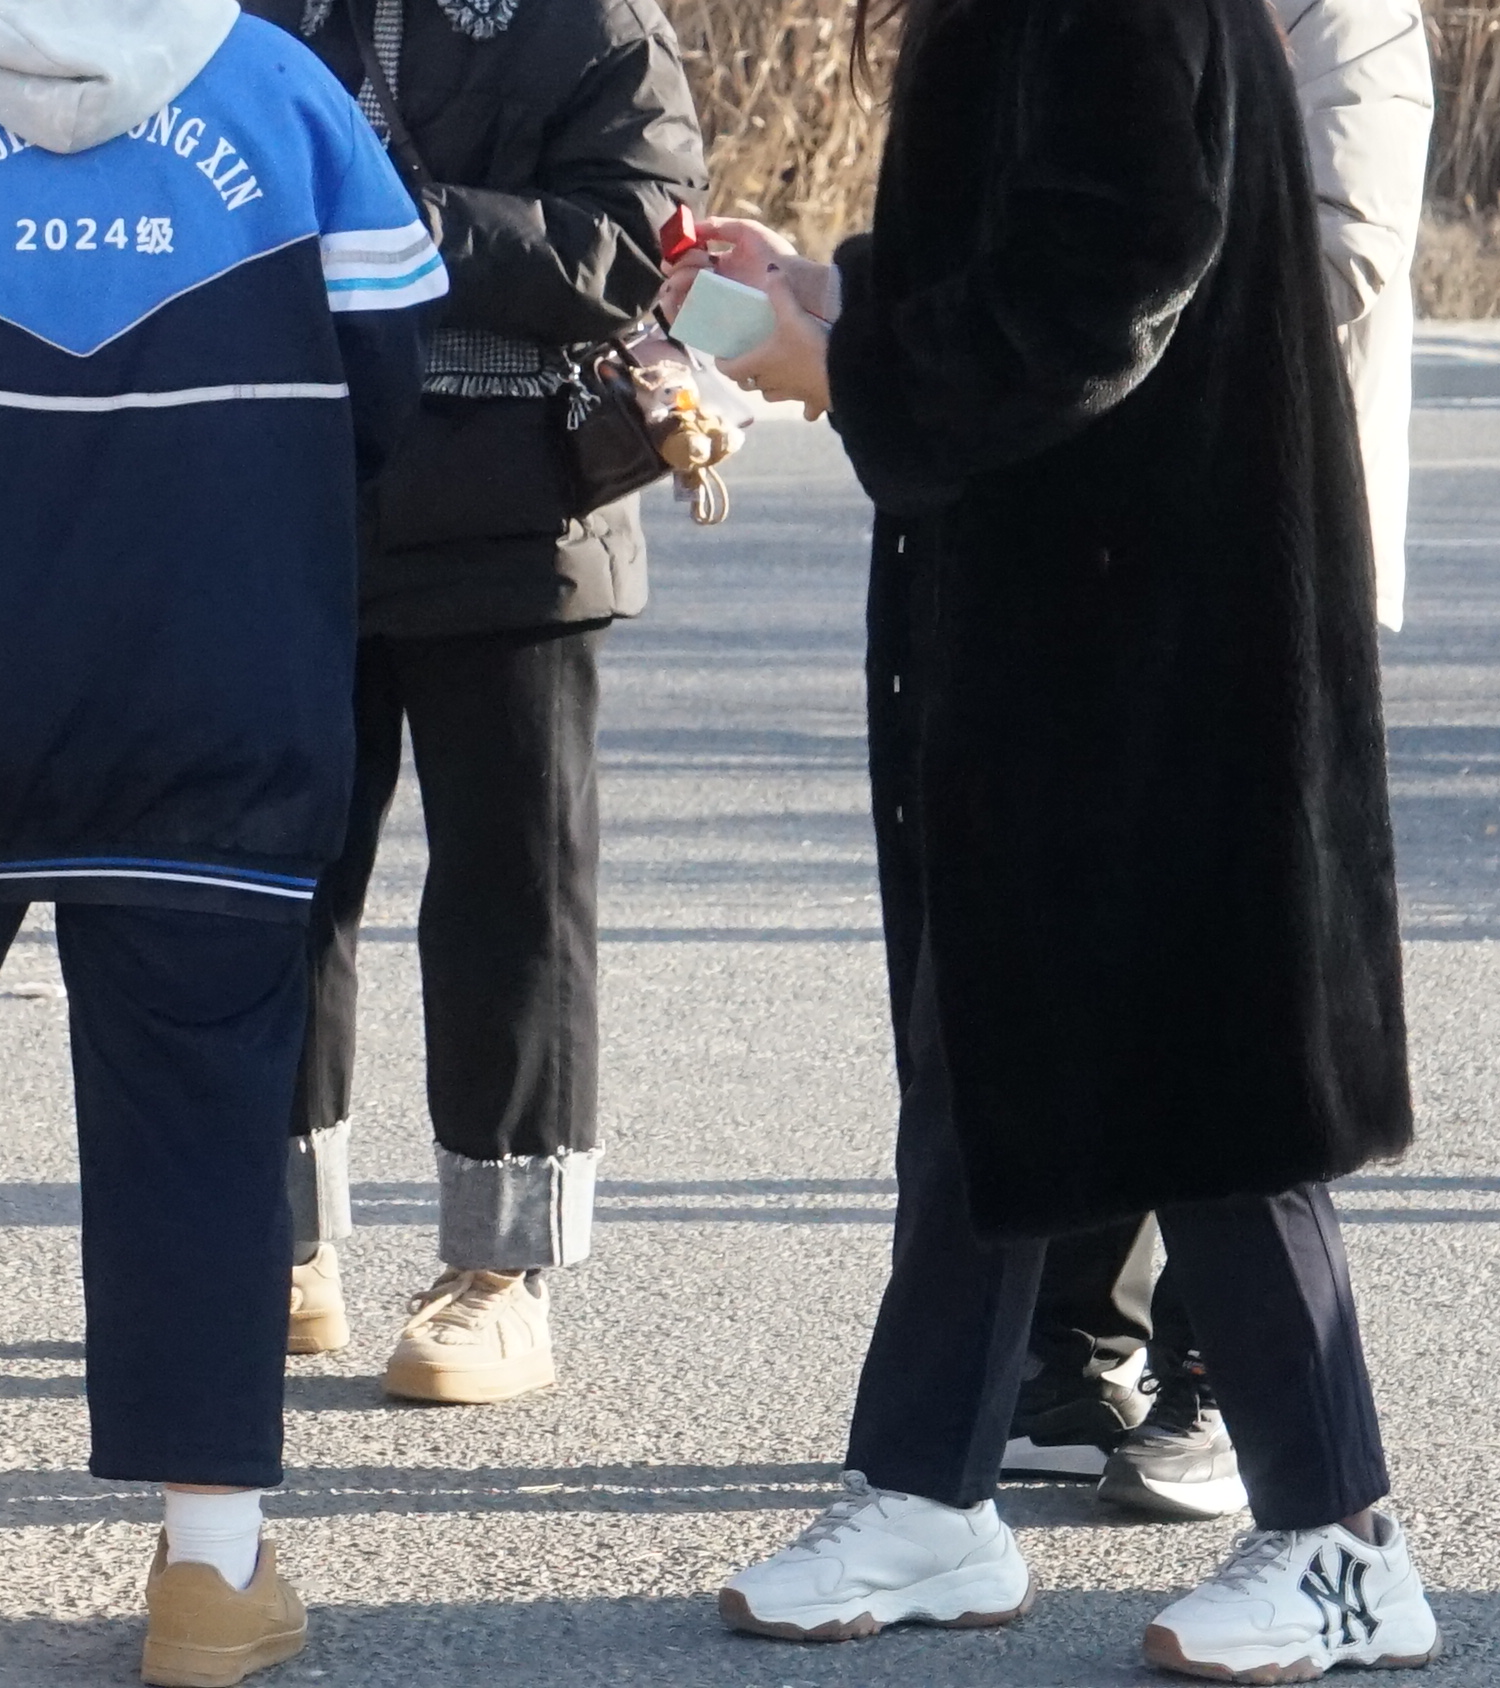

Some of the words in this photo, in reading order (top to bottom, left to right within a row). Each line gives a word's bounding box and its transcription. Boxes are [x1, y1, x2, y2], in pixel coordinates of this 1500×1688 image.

[195, 136, 264, 212] XIN
[14, 215, 175, 255] 2024级
[1297, 1542, 1382, 1649] NY
